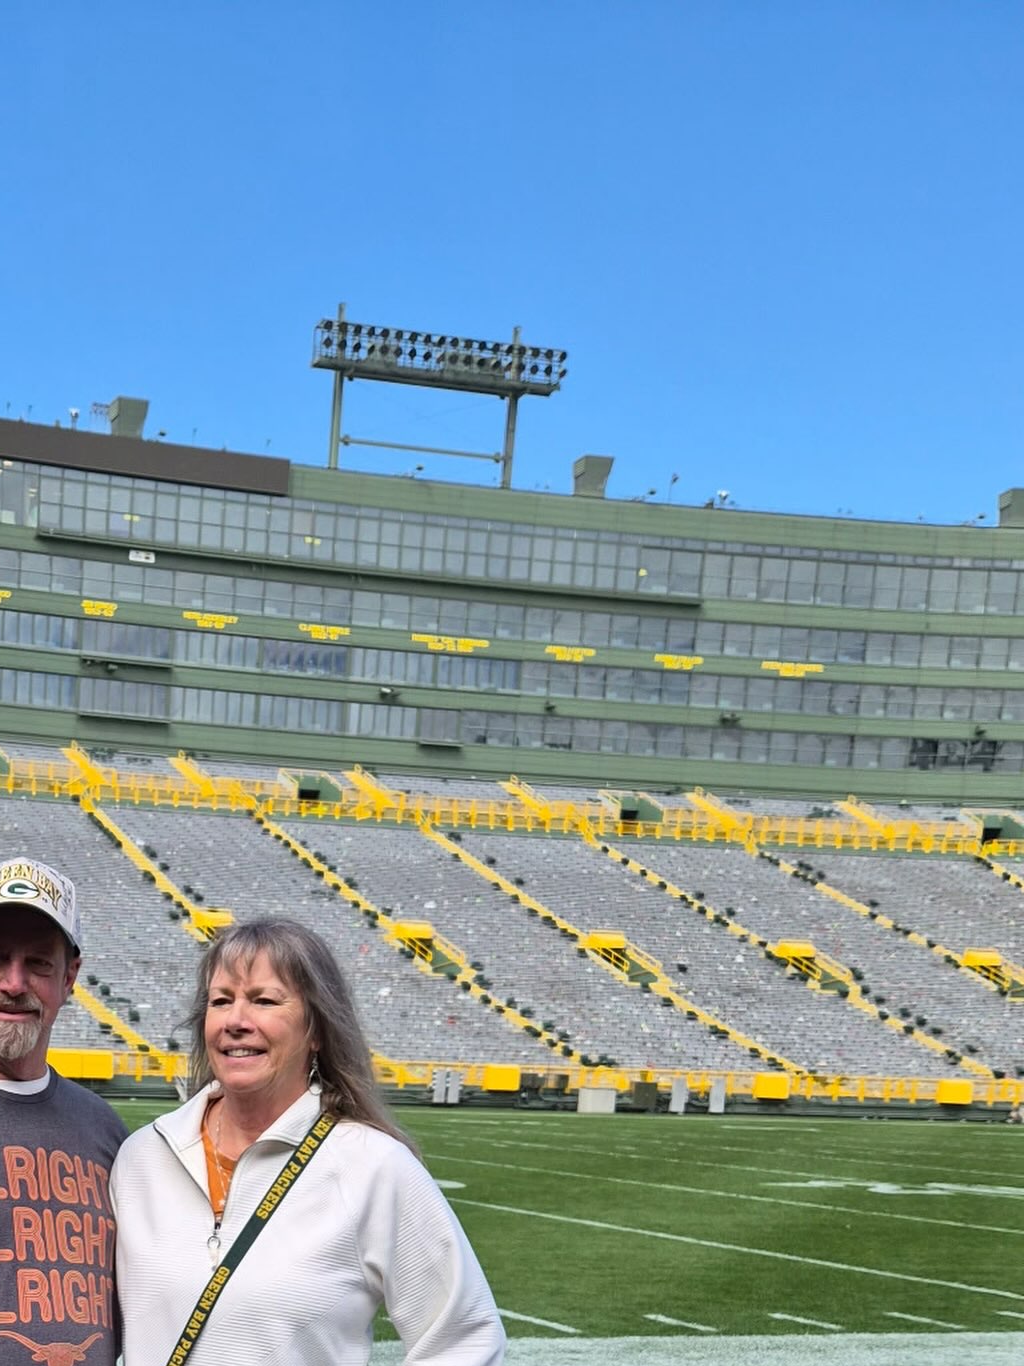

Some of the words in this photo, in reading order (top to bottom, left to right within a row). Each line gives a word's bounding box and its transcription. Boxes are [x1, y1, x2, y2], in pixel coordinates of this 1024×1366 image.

[37, 871, 62, 911] BAY
[312, 1113, 333, 1139] EEN
[295, 1136, 319, 1164] BAY
[256, 1160, 302, 1220] PACKERS
[199, 1266, 230, 1310] GREEN
[186, 1310, 206, 1338] BAY
